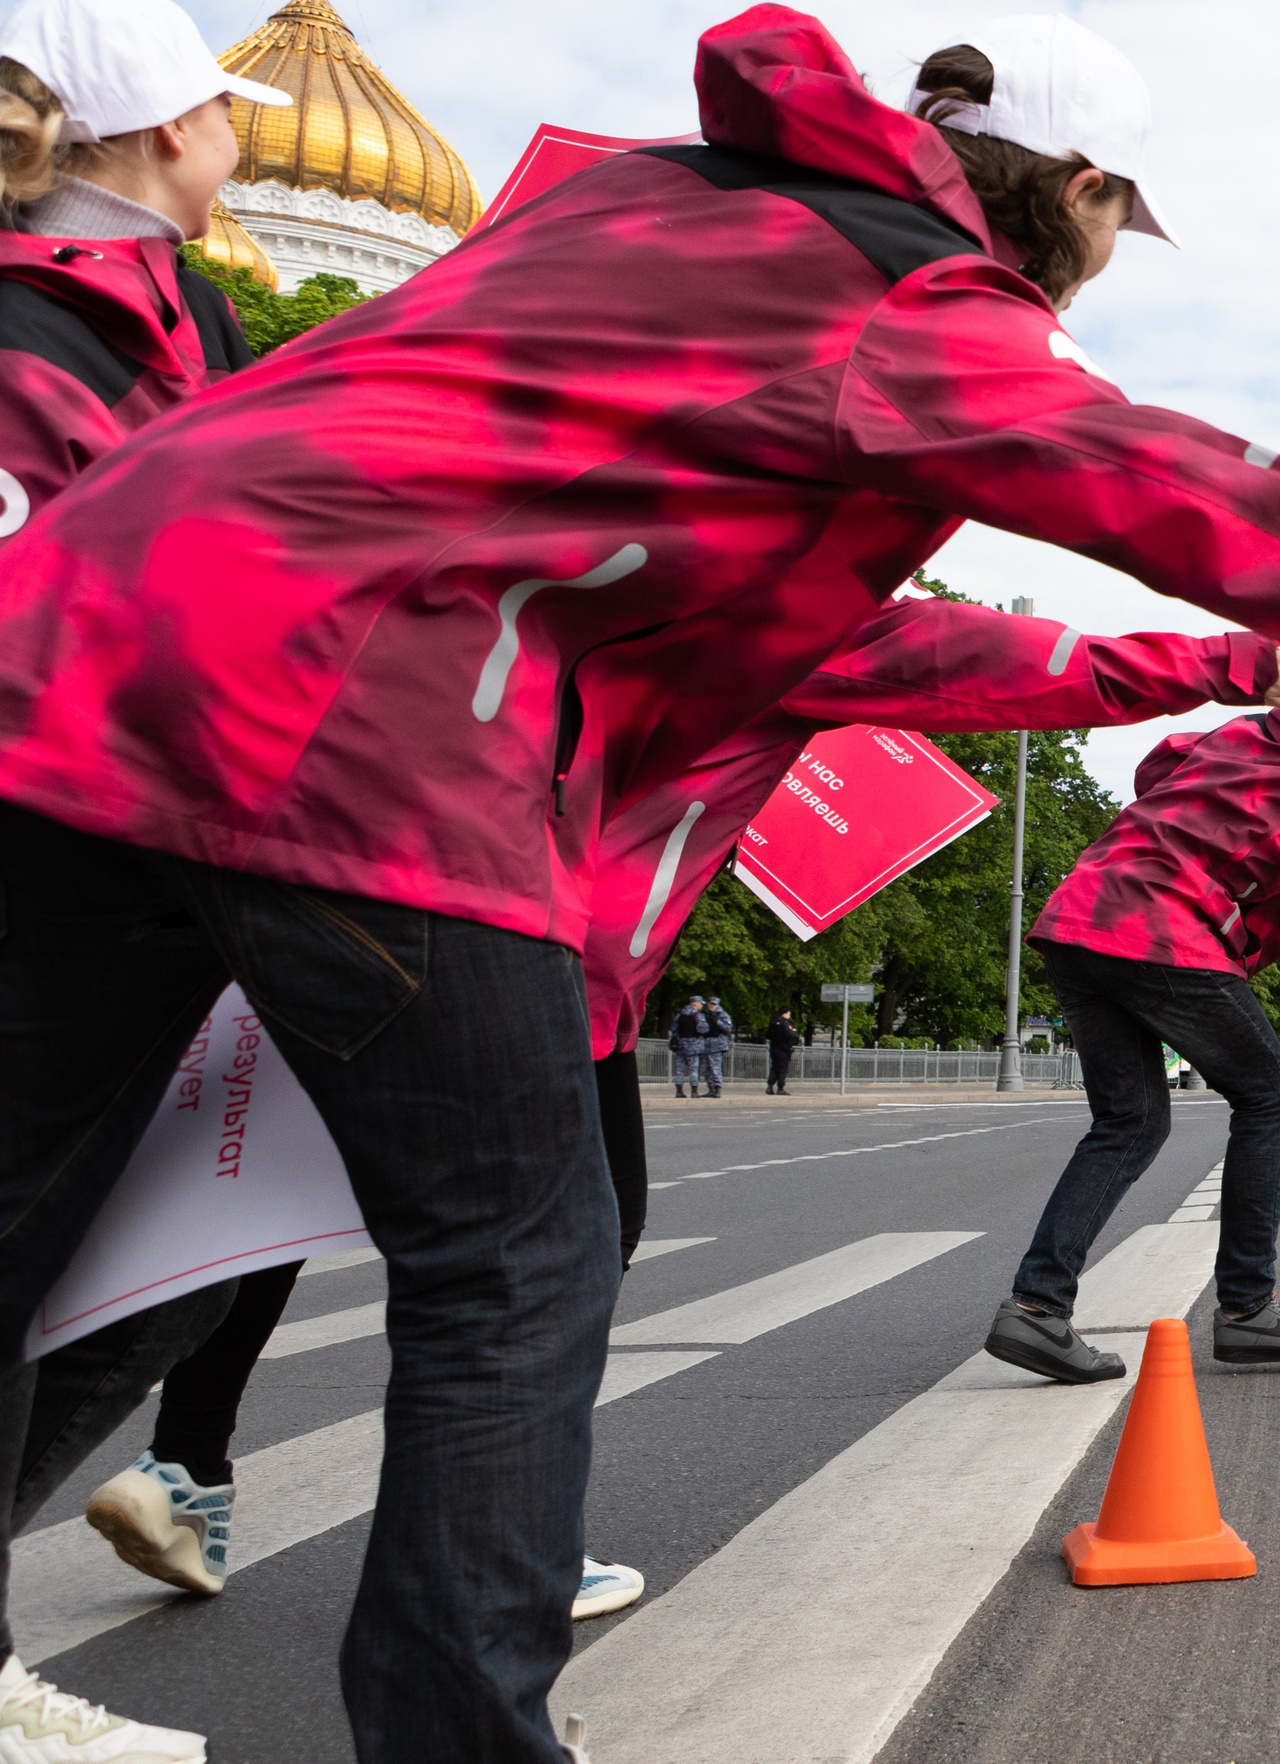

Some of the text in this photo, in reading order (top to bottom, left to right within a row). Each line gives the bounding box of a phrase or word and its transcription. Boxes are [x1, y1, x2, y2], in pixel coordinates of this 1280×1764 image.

[808, 760, 844, 791] нас
[745, 825, 769, 846] кат
[216, 1013, 264, 1179] результат
